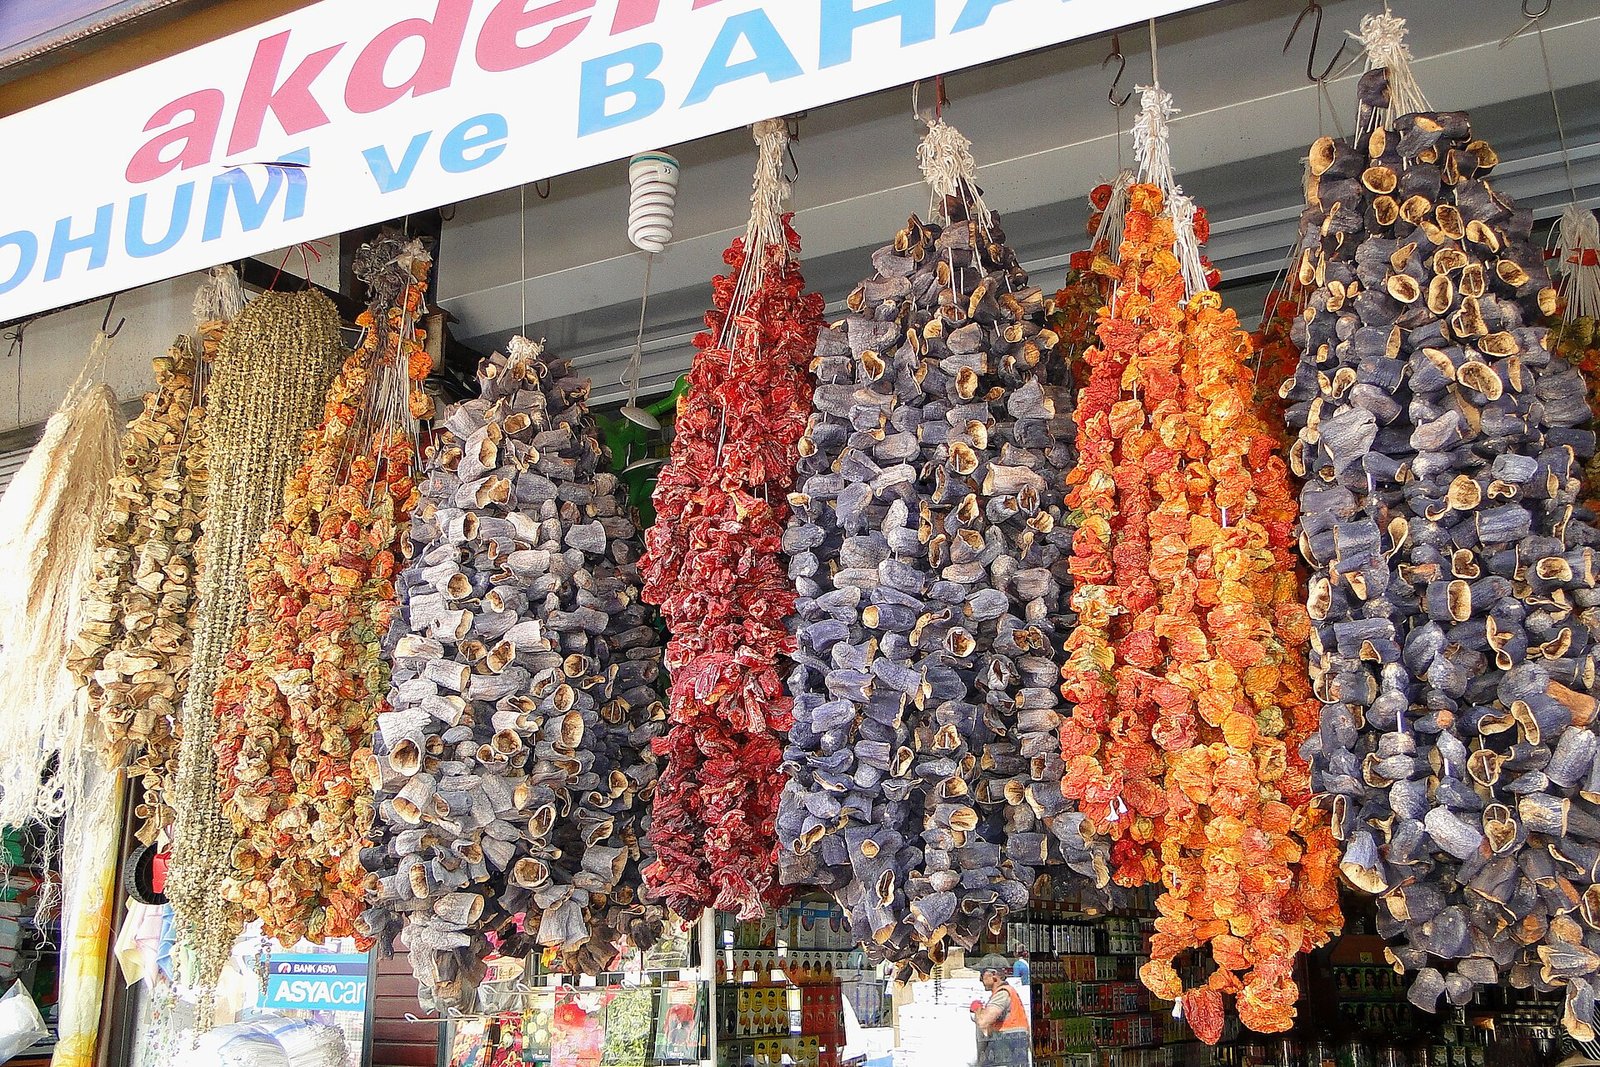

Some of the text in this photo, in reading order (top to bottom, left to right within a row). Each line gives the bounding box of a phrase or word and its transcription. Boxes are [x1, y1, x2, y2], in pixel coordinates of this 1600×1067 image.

[362, 111, 508, 195] ve
[293, 963, 338, 974] BANK ASYA
[274, 980, 367, 1004] ASYAcar
